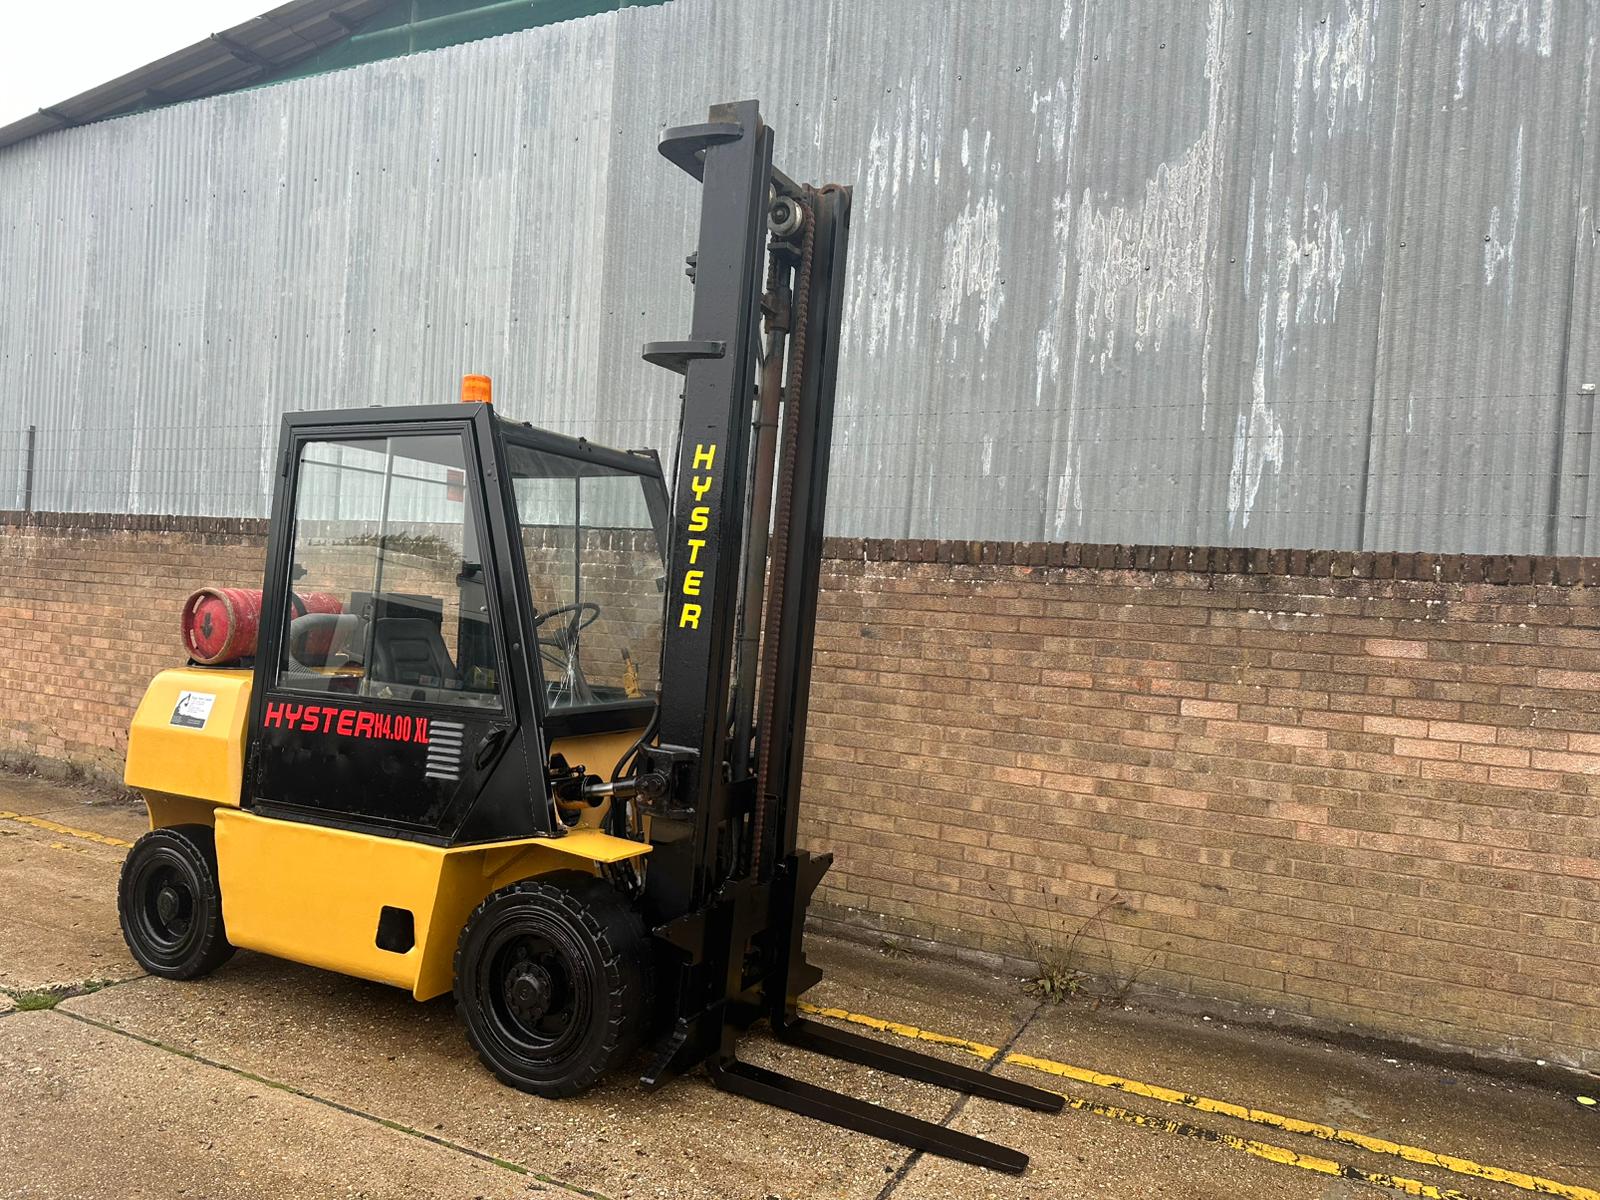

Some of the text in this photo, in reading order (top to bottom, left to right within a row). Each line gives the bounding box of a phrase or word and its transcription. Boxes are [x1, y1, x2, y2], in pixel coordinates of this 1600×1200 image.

[679, 444, 716, 629] HYSTER
[264, 702, 429, 744] HYSTER H4.00 XL
